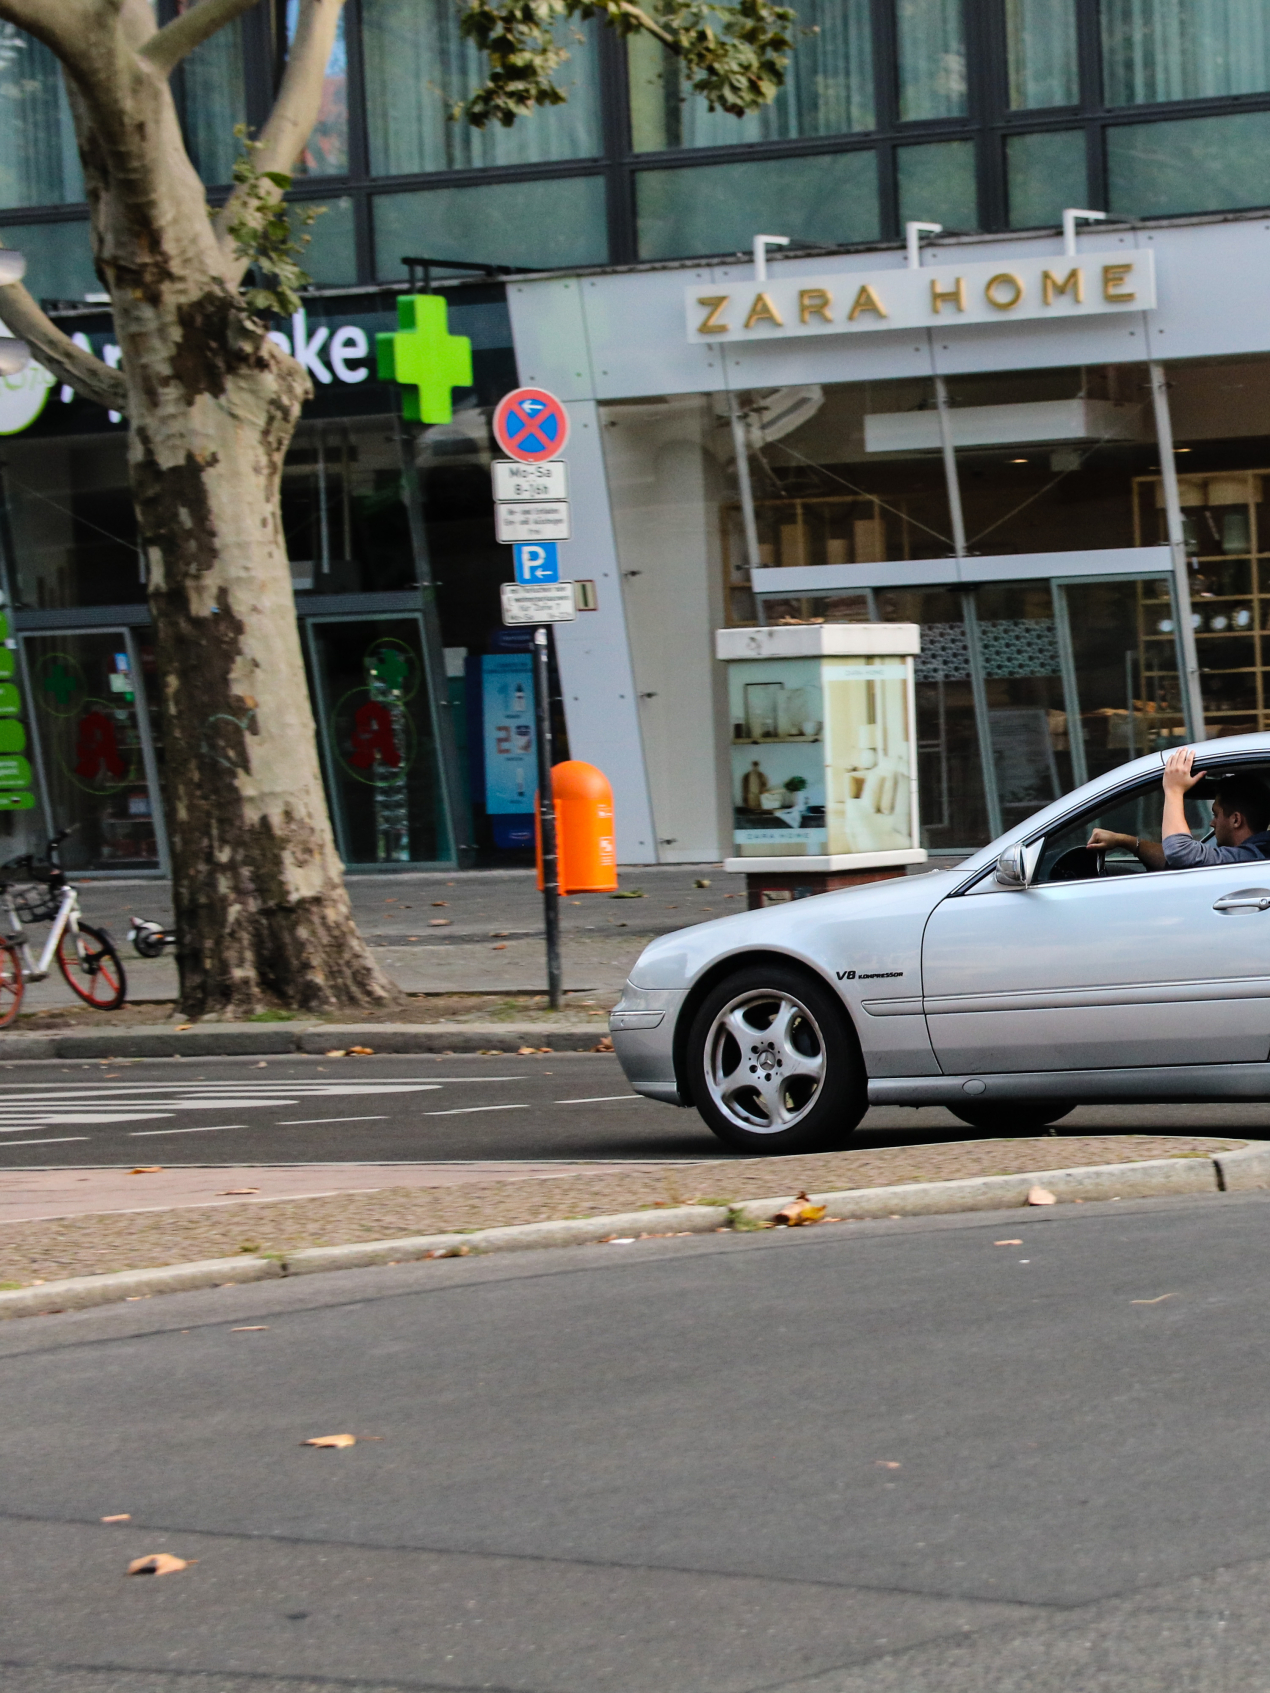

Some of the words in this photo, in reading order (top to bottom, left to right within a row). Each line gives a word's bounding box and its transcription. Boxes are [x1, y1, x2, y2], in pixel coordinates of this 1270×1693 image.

[697, 284, 888, 333] ZARA
[931, 263, 1137, 314] HOME
[509, 466, 552, 479] Mo-Sa
[521, 546, 546, 580] P
[836, 970, 856, 981] V8
